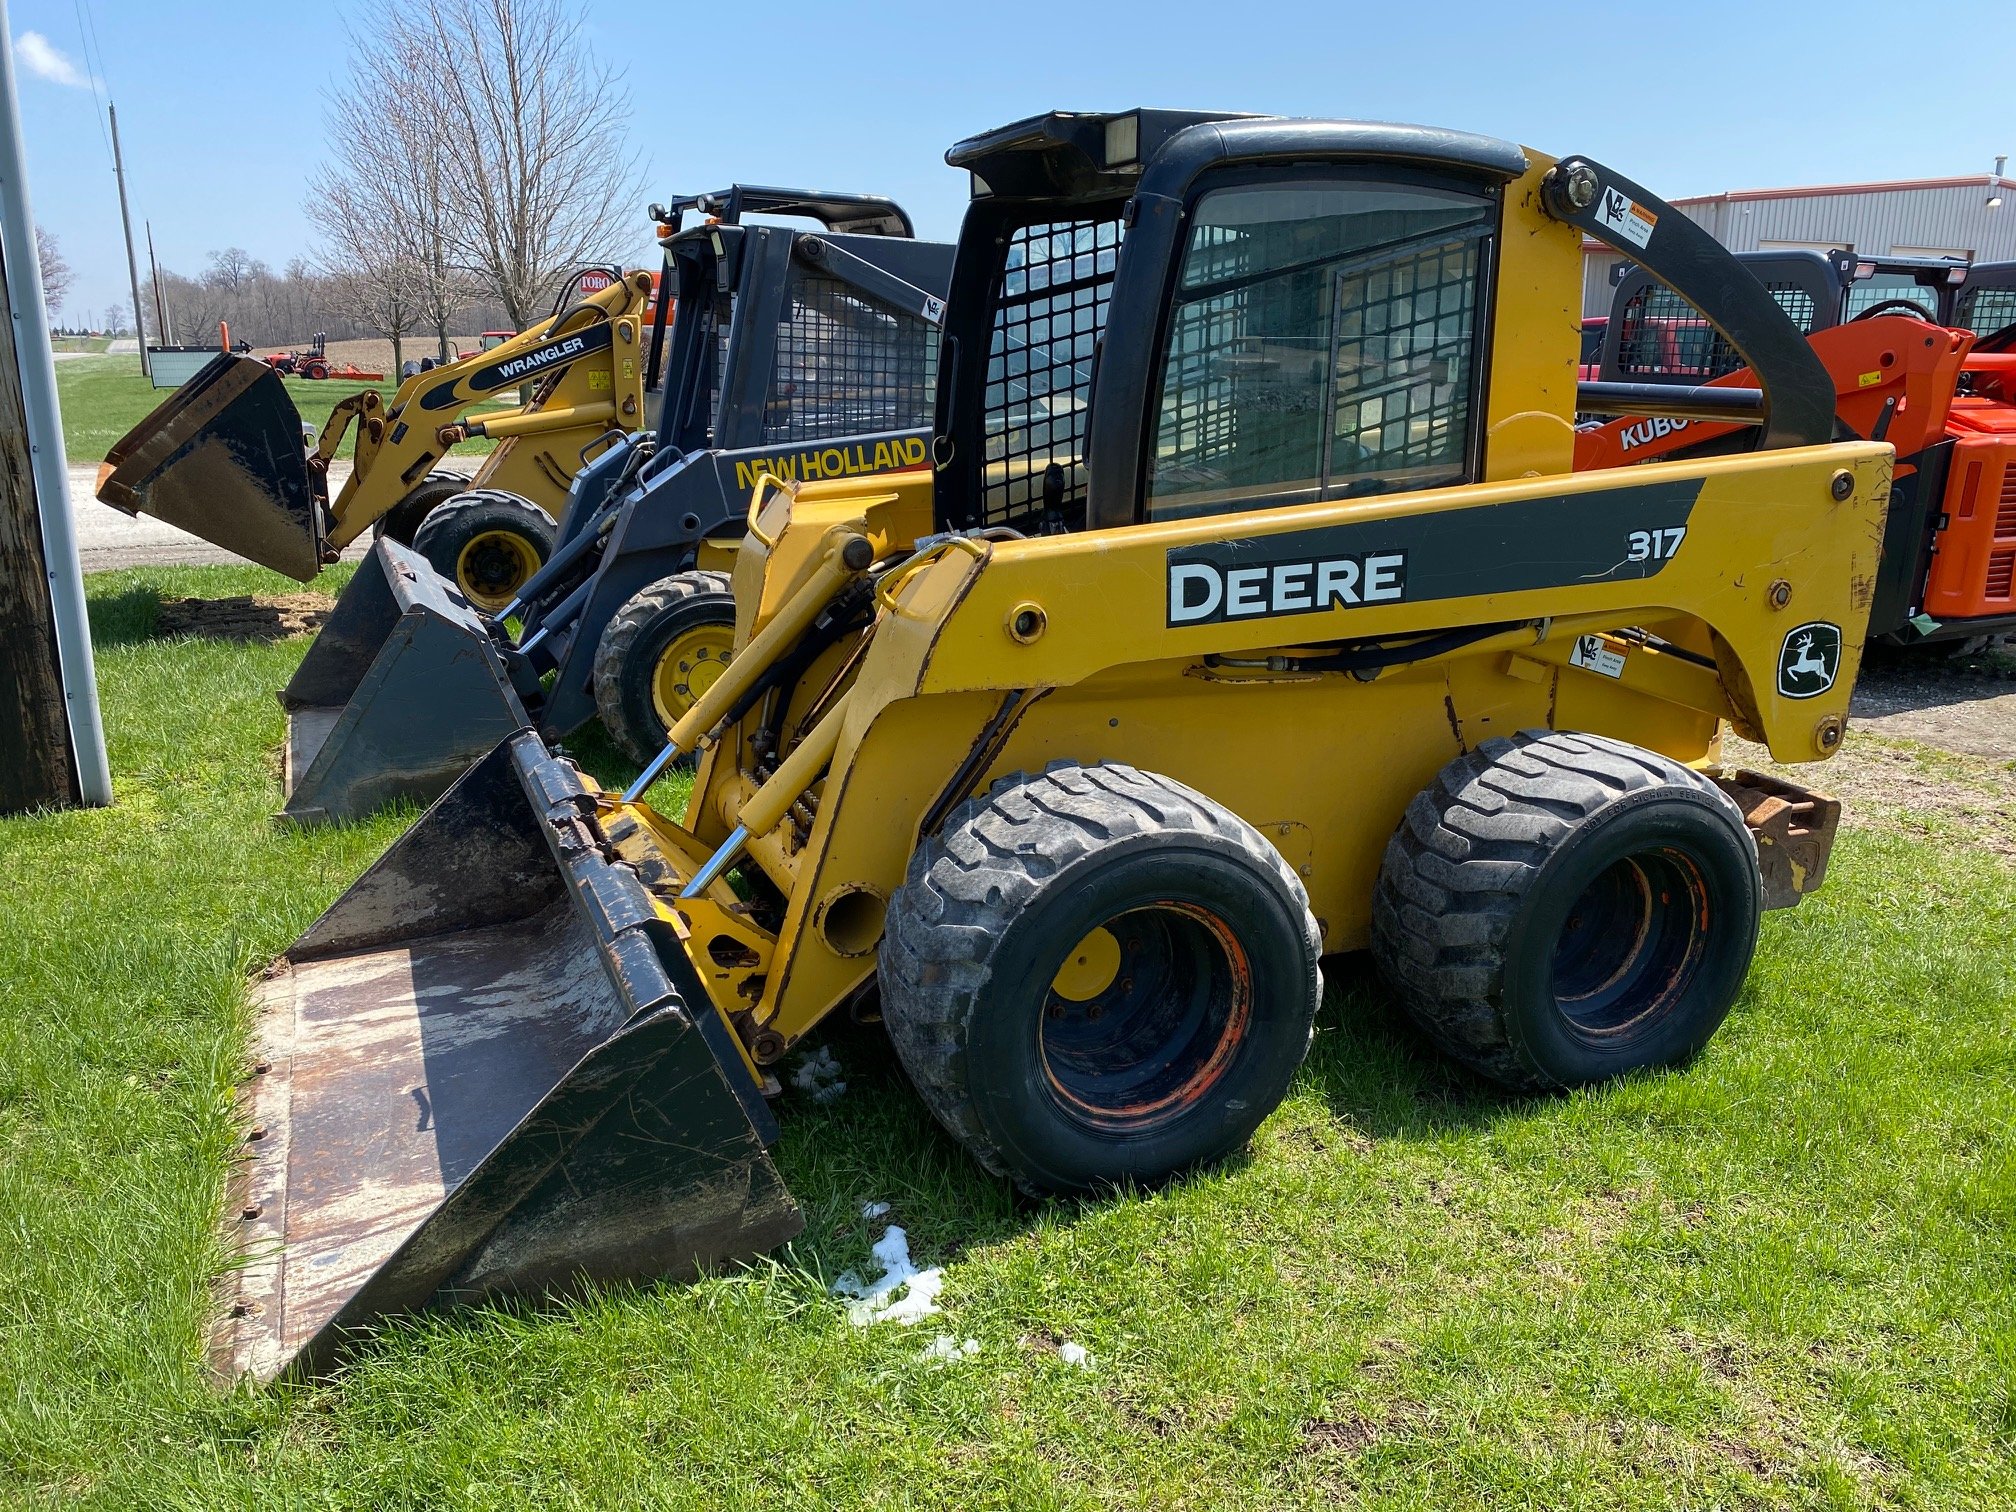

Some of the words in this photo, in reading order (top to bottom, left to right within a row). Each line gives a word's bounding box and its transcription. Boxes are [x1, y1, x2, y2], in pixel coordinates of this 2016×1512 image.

[581, 276, 611, 289] TORO
[498, 337, 585, 379] WRANGLER
[1620, 416, 1704, 451] KUBO
[735, 454, 797, 490] NEW
[800, 437, 926, 480] HOLLAND
[1627, 526, 1687, 563] 317
[1169, 553, 1404, 622] DEERE
